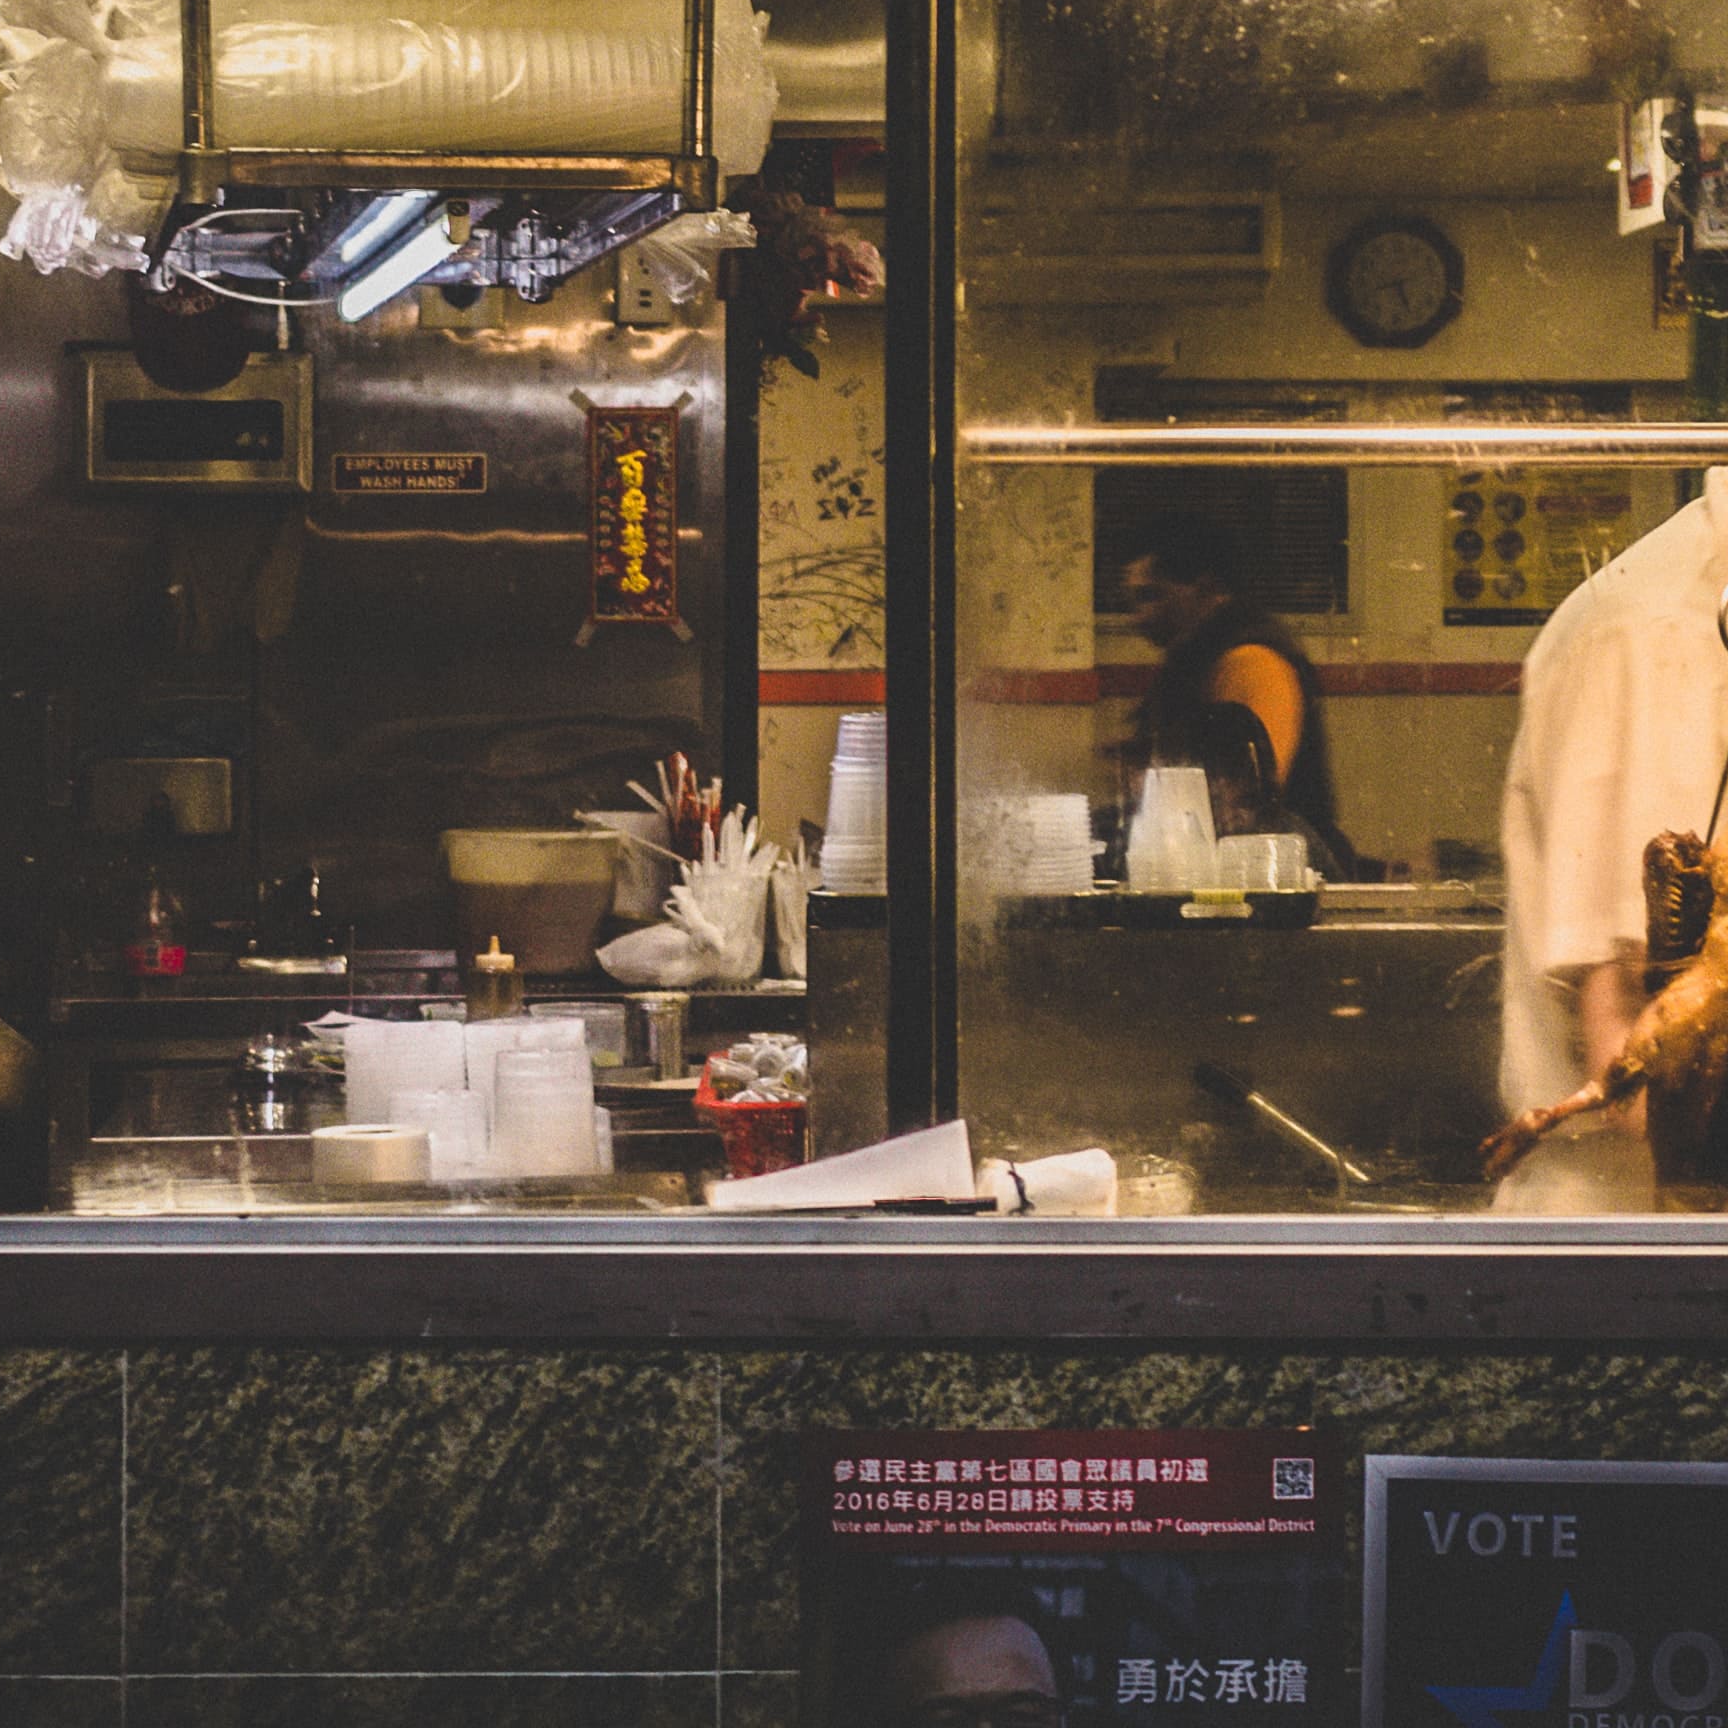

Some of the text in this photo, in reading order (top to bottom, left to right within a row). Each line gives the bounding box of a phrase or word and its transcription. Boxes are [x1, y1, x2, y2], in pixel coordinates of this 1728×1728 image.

[344, 457, 475, 471] EMPLOYEES MUST
[360, 475, 458, 489] WASH HANDS
[833, 1488, 1135, 1511] 2016年6月28日請投票支持
[832, 1519, 862, 1532] Vote
[864, 1522, 881, 1532] on
[884, 1519, 914, 1532] June
[944, 1519, 956, 1532] in
[960, 1518, 982, 1532] the
[985, 1518, 1057, 1532] Democratic
[1061, 1518, 1112, 1535] Primary
[1115, 1518, 1128, 1532] in
[1130, 1518, 1152, 1532] the
[1155, 1518, 1172, 1532] 7th
[1175, 1517, 1266, 1535] Congressional
[1268, 1517, 1316, 1532] District
[1423, 1511, 1580, 1558] VOTE
[1118, 1658, 1308, 1704] 勇於承擔
